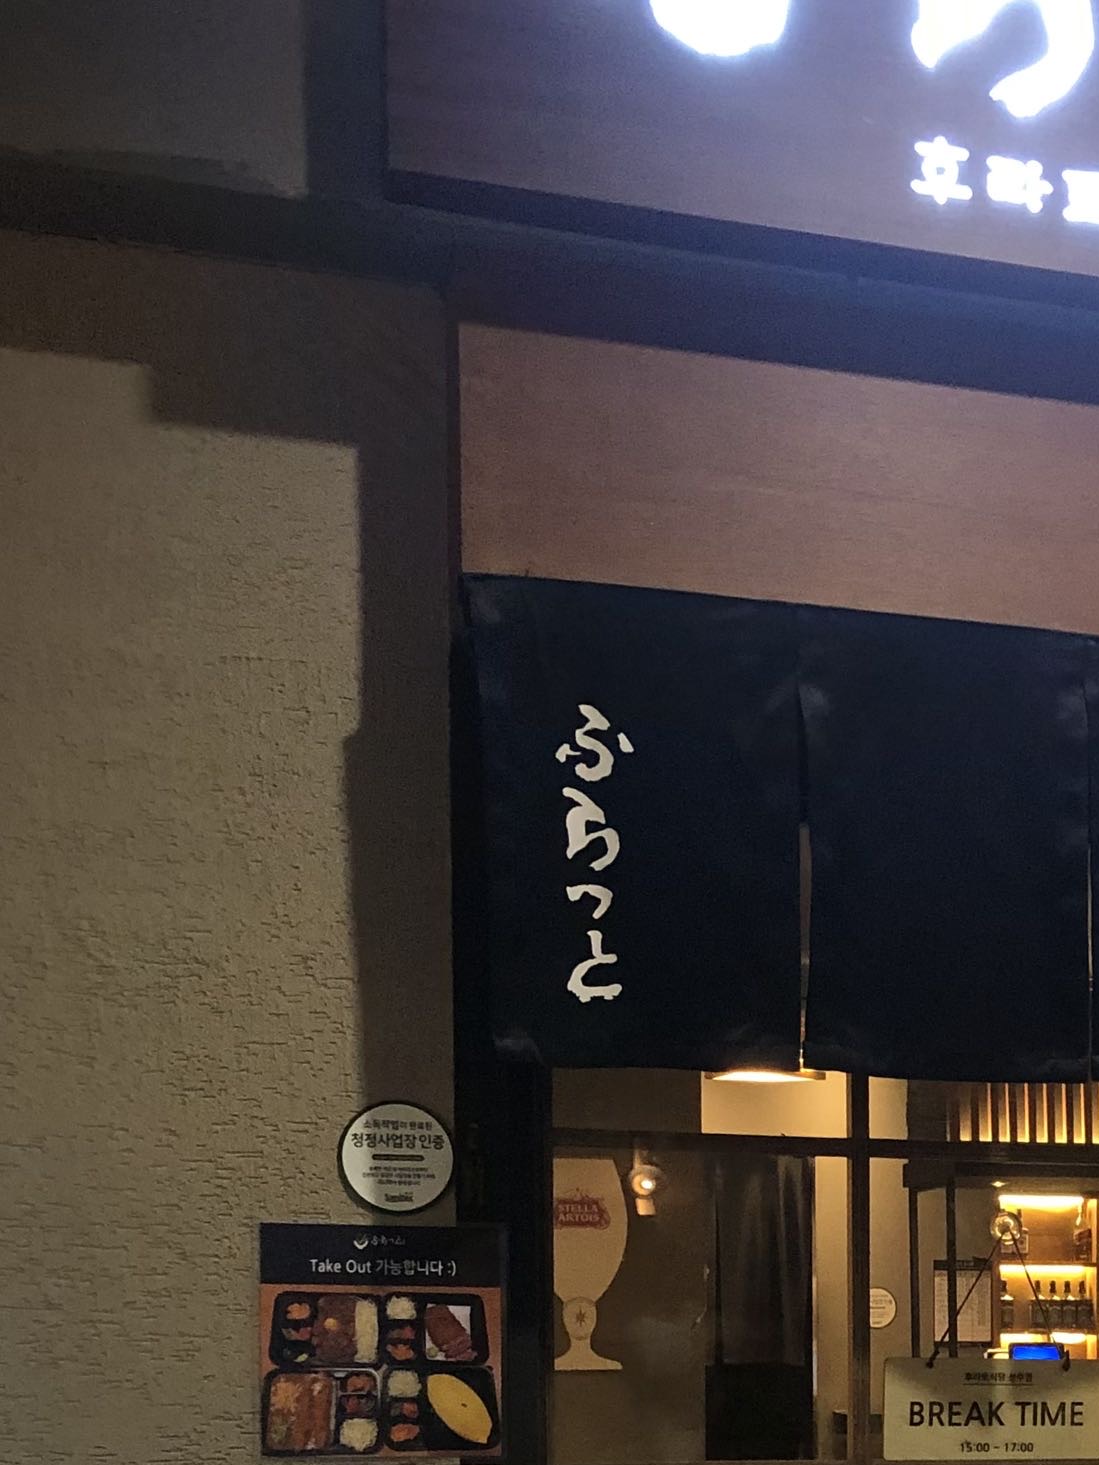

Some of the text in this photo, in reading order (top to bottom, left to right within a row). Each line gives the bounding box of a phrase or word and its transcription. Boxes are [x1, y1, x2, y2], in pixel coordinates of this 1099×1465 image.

[555, 704, 634, 1002] ふらっと
[419, 1134, 445, 1150] 인증
[309, 1258, 342, 1273] Take
[345, 1259, 372, 1274] Out
[375, 1259, 444, 1276] 가능합니다
[909, 1401, 1084, 1427] BREAK TIME
[960, 1441, 990, 1453] 15:00
[1004, 1442, 1034, 1453] 17:00
